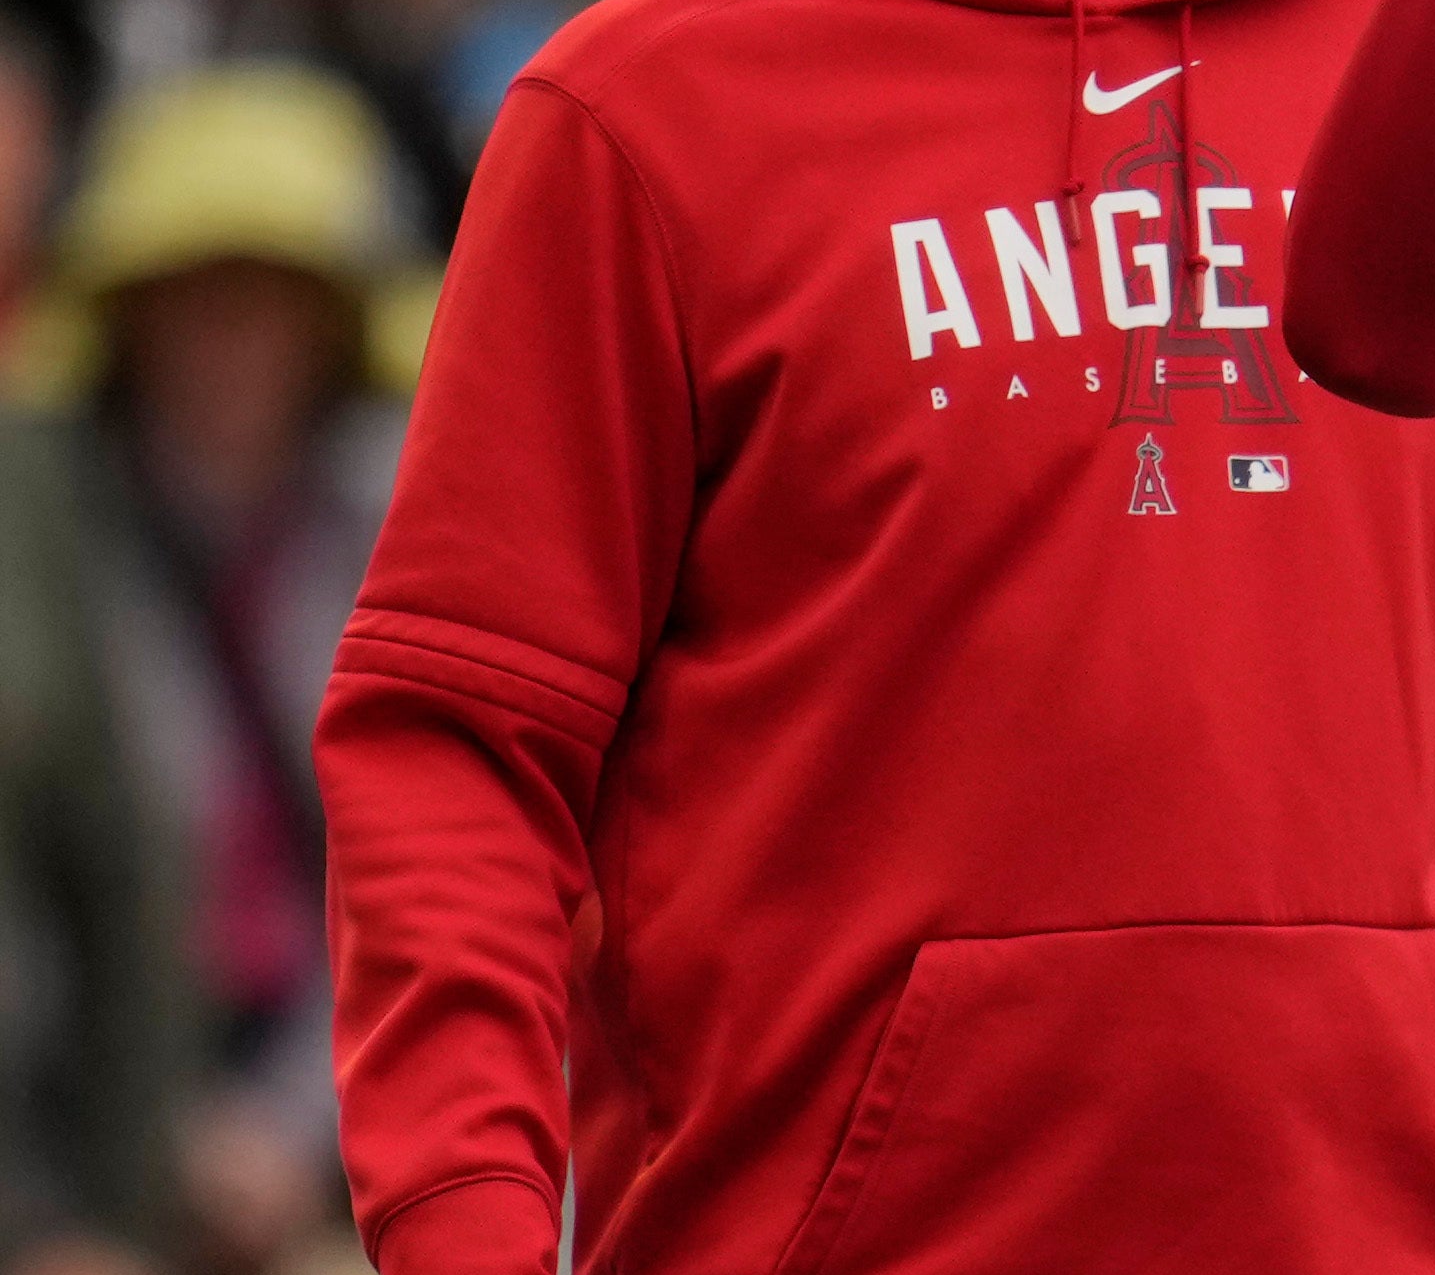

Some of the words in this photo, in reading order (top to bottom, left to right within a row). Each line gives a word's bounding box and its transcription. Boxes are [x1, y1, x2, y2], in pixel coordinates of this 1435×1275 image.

[891, 187, 1296, 361] ANGE
[930, 359, 1317, 411] BASEB
[1128, 433, 1178, 516] A
